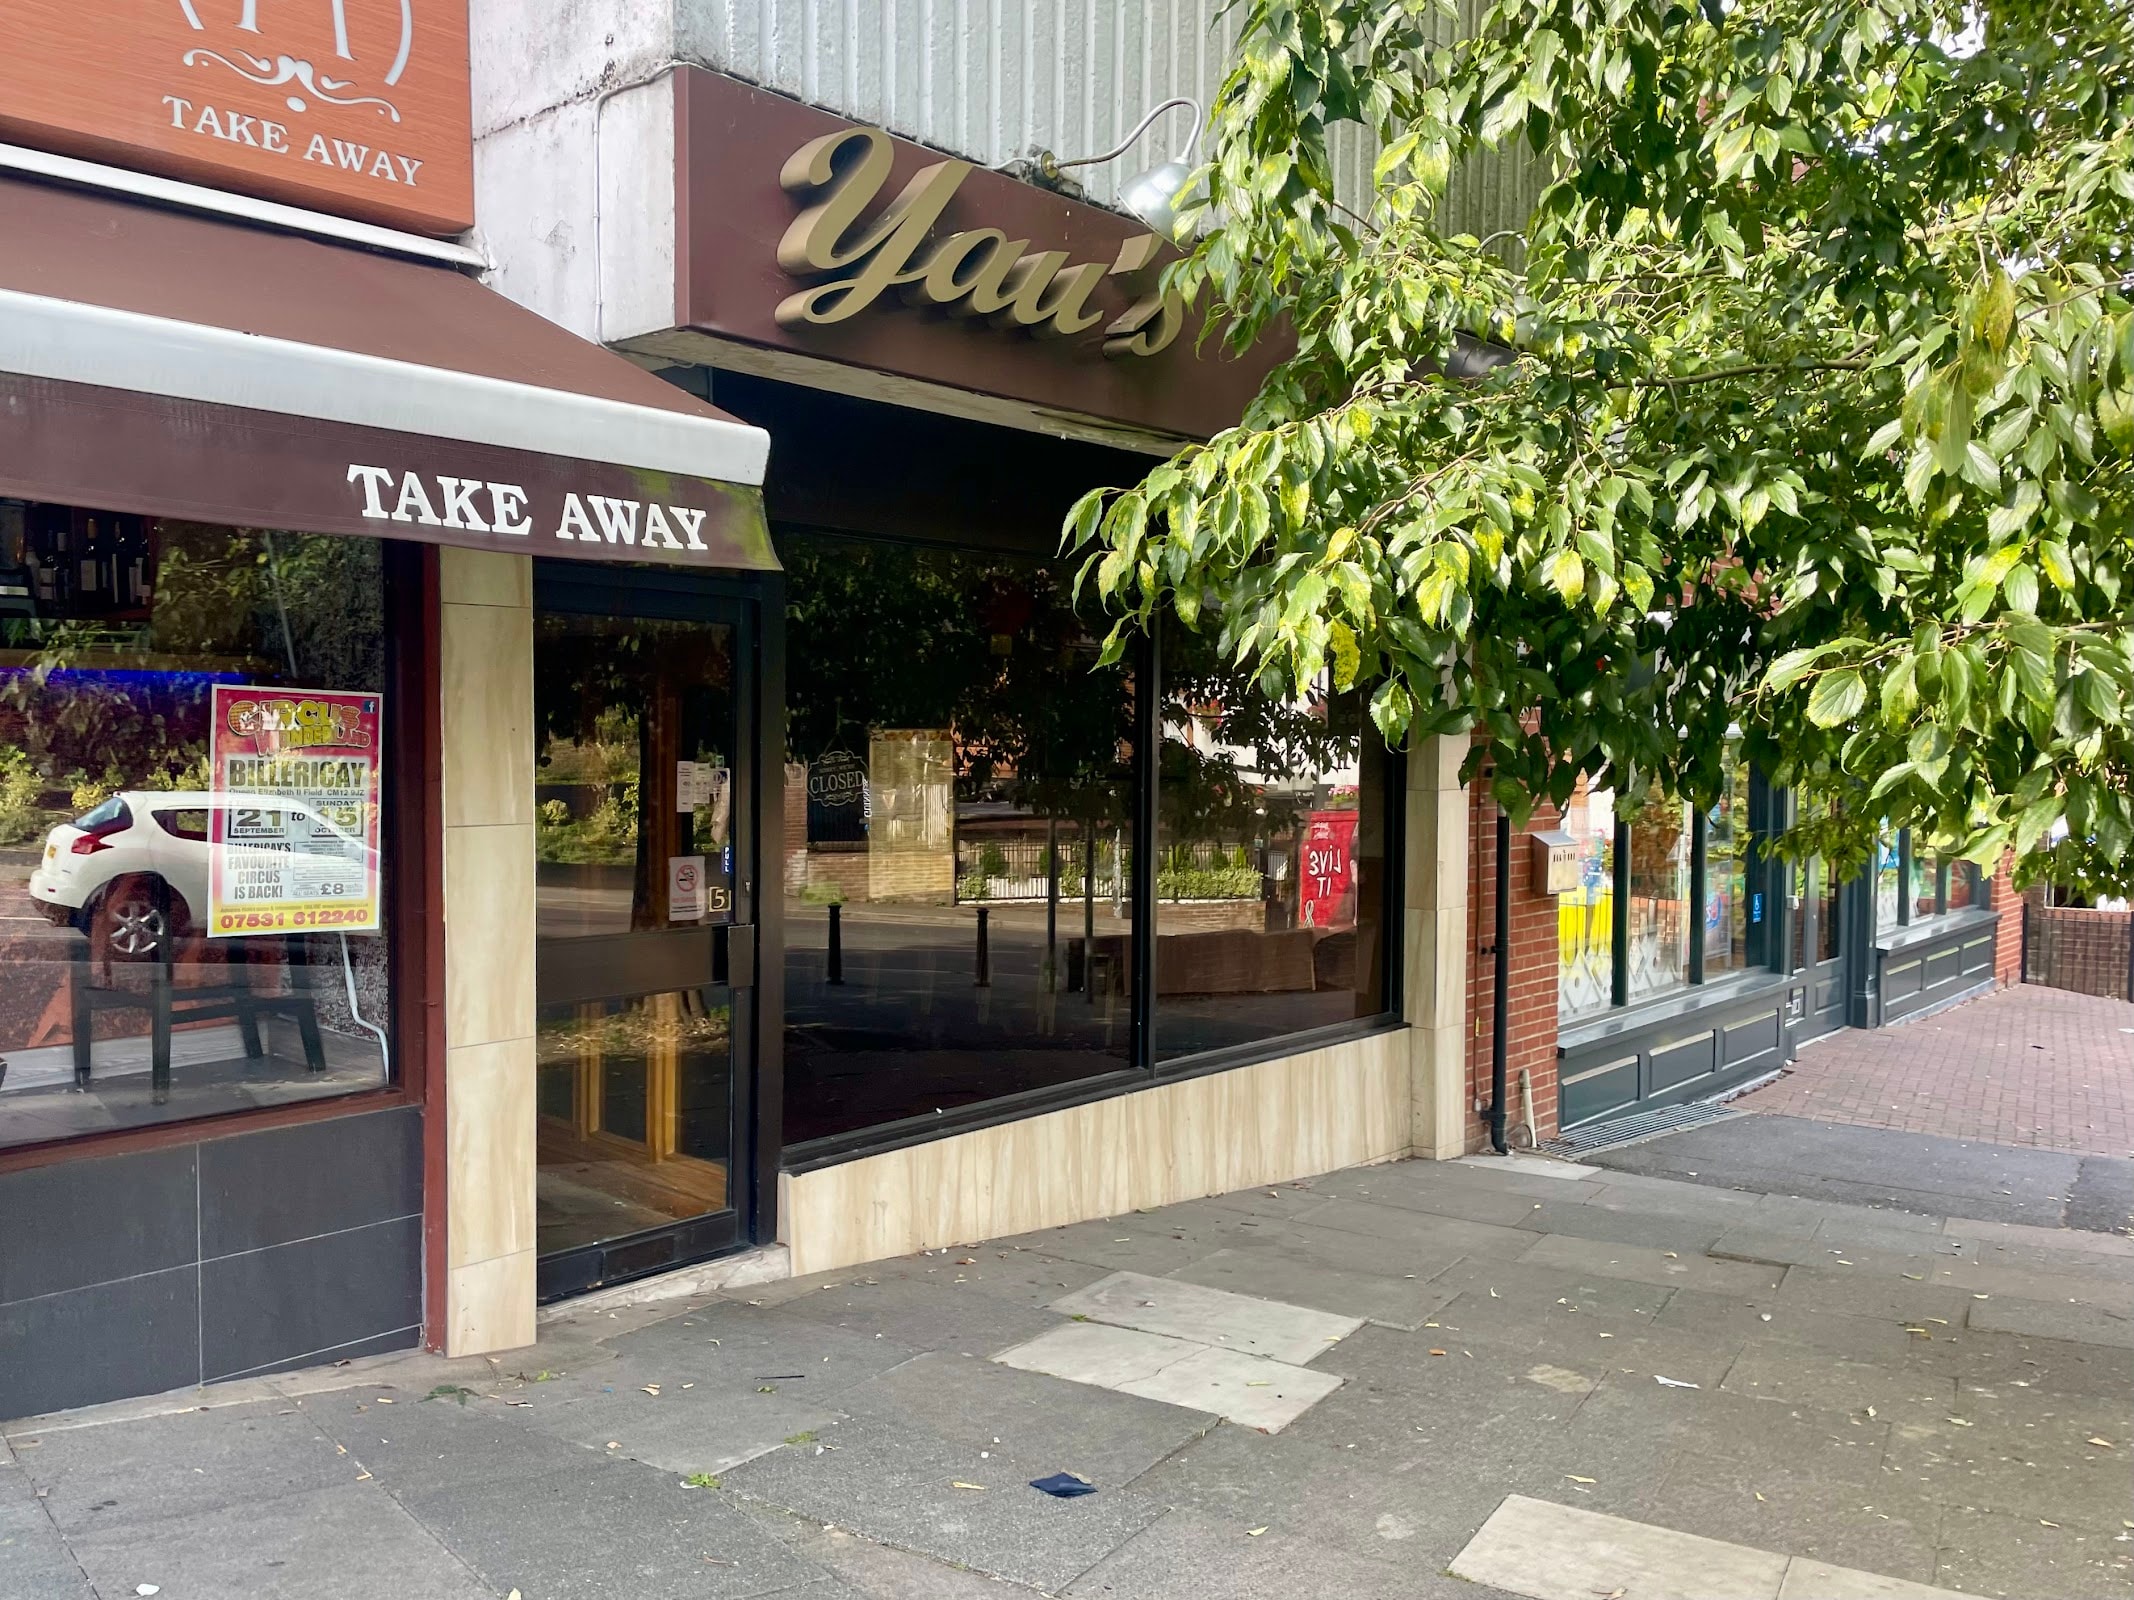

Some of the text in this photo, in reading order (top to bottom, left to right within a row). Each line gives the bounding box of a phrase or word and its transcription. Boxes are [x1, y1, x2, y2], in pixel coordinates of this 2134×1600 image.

[162, 95, 425, 187] TAKE AWAY
[774, 126, 1184, 359] Yau's
[347, 464, 709, 551] TAKE AWAY
[228, 700, 360, 735] CIRCUS
[255, 724, 371, 757] WONDERLAND
[229, 759, 366, 788] BILLERICAY
[810, 770, 865, 794] CLOSED
[236, 808, 281, 827] 21
[291, 811, 306, 822] to
[228, 855, 290, 870] FAVOURITE
[238, 870, 280, 884] CIRCUS
[234, 886, 246, 900] IS
[248, 885, 283, 899] BACK!
[320, 883, 345, 895] £8
[712, 888, 726, 909] 5
[220, 909, 368, 929] 07531 612240
